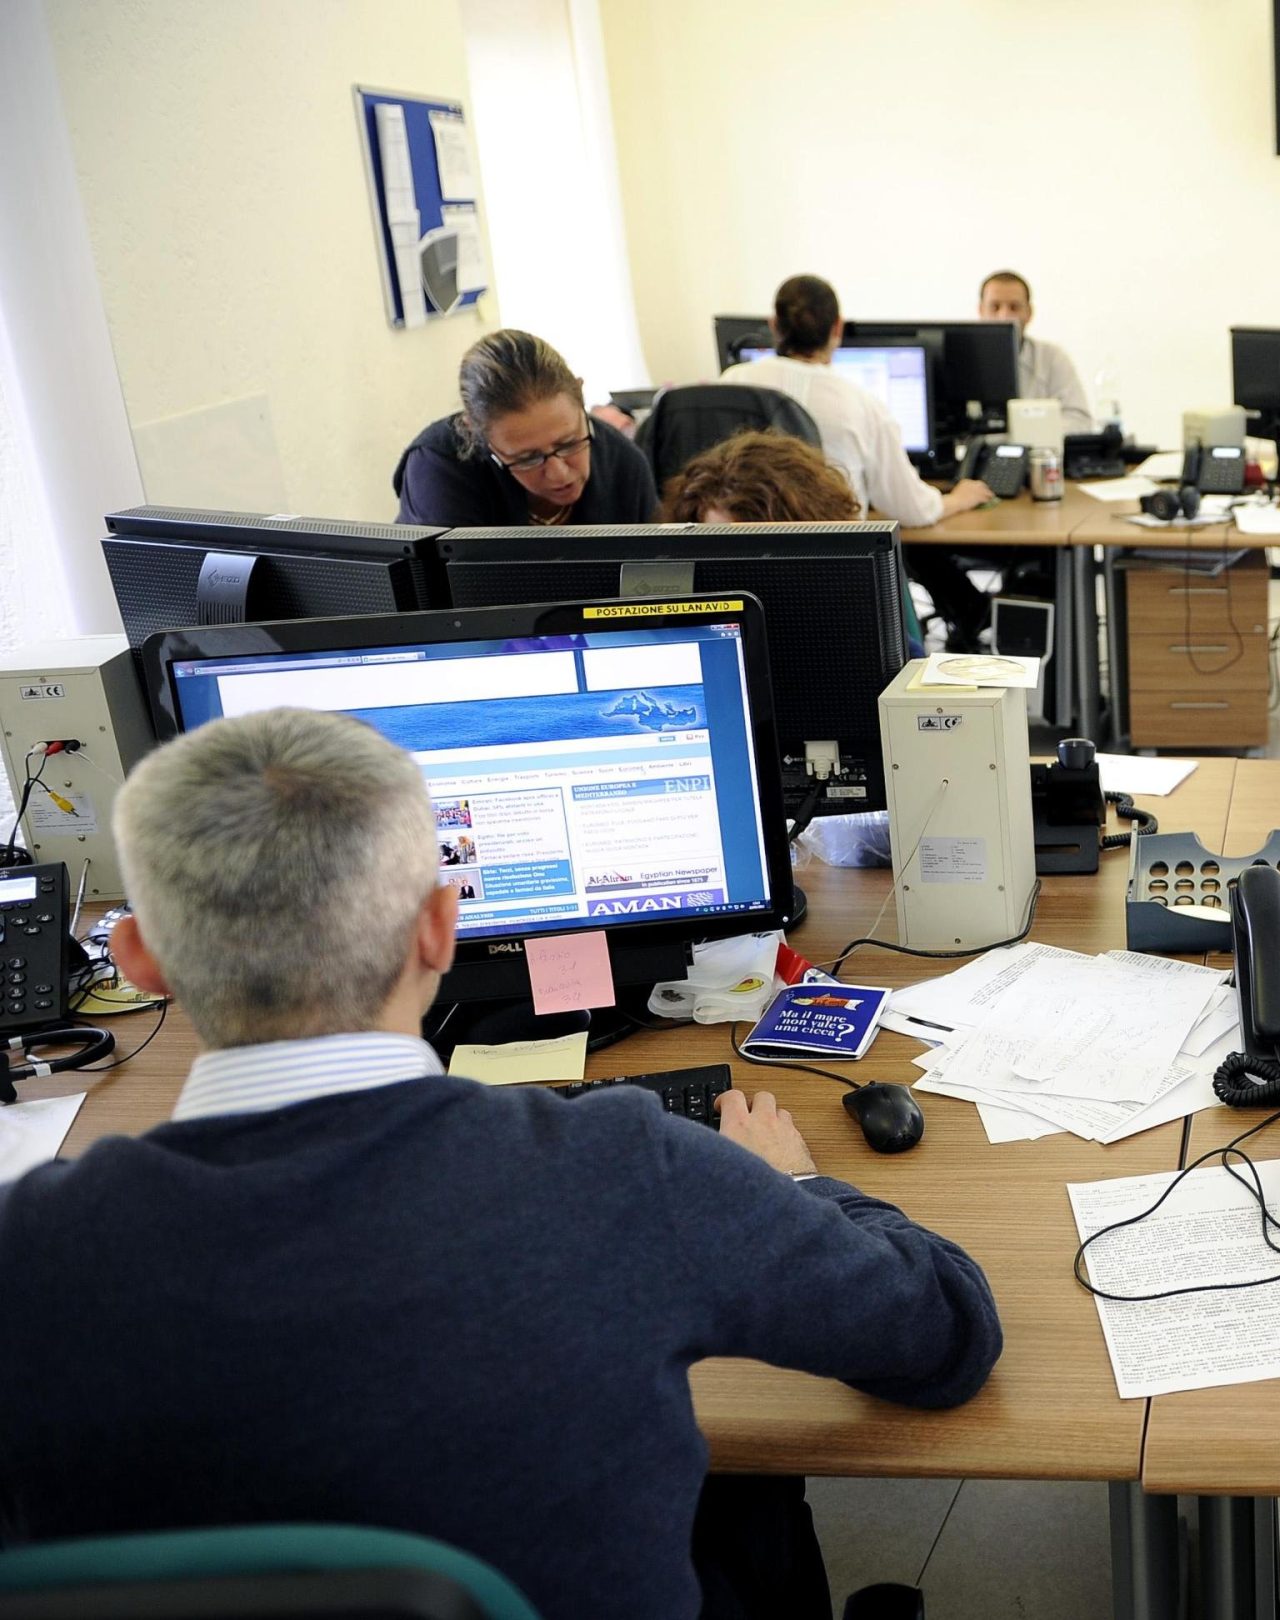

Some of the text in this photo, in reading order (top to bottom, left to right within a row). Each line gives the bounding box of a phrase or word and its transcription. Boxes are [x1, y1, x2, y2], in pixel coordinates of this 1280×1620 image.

[596, 605, 664, 617] POSTAZIONE
[666, 603, 680, 613] SU
[682, 602, 703, 612] LAN
[664, 777, 709, 794] ENPI
[640, 866, 718, 880] Egyptian Newspaper
[591, 894, 682, 918] AMAN
[488, 942, 523, 955] DELL
[779, 1010, 847, 1023] Ma il mare
[774, 1025, 799, 1033] una
[782, 1018, 838, 1030] non vale
